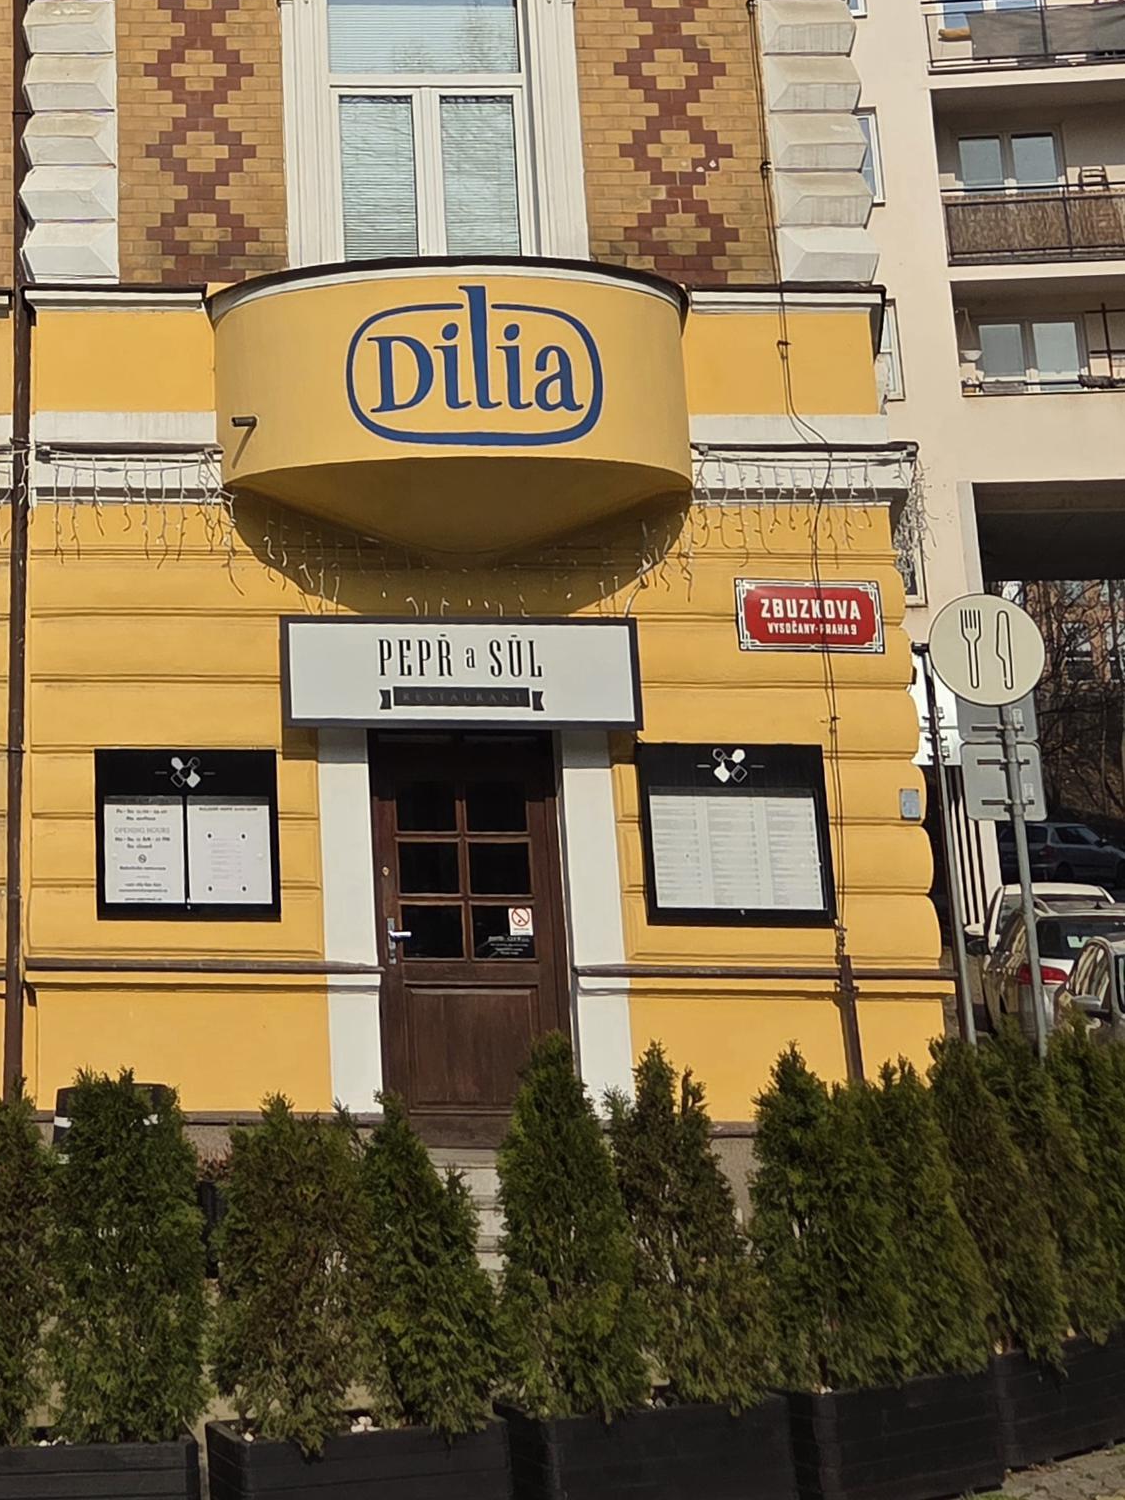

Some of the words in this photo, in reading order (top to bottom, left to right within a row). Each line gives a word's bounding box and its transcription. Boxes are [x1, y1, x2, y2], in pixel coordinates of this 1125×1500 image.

[367, 285, 584, 413] Dilia
[760, 598, 861, 620] ZBUZKOVA
[767, 620, 815, 635] VYSOČANY
[851, 624, 857, 635] 9
[378, 633, 453, 677] PEPŘ
[465, 647, 476, 669] a
[488, 634, 543, 678] SŮL
[401, 691, 522, 703] RESTAURANT
